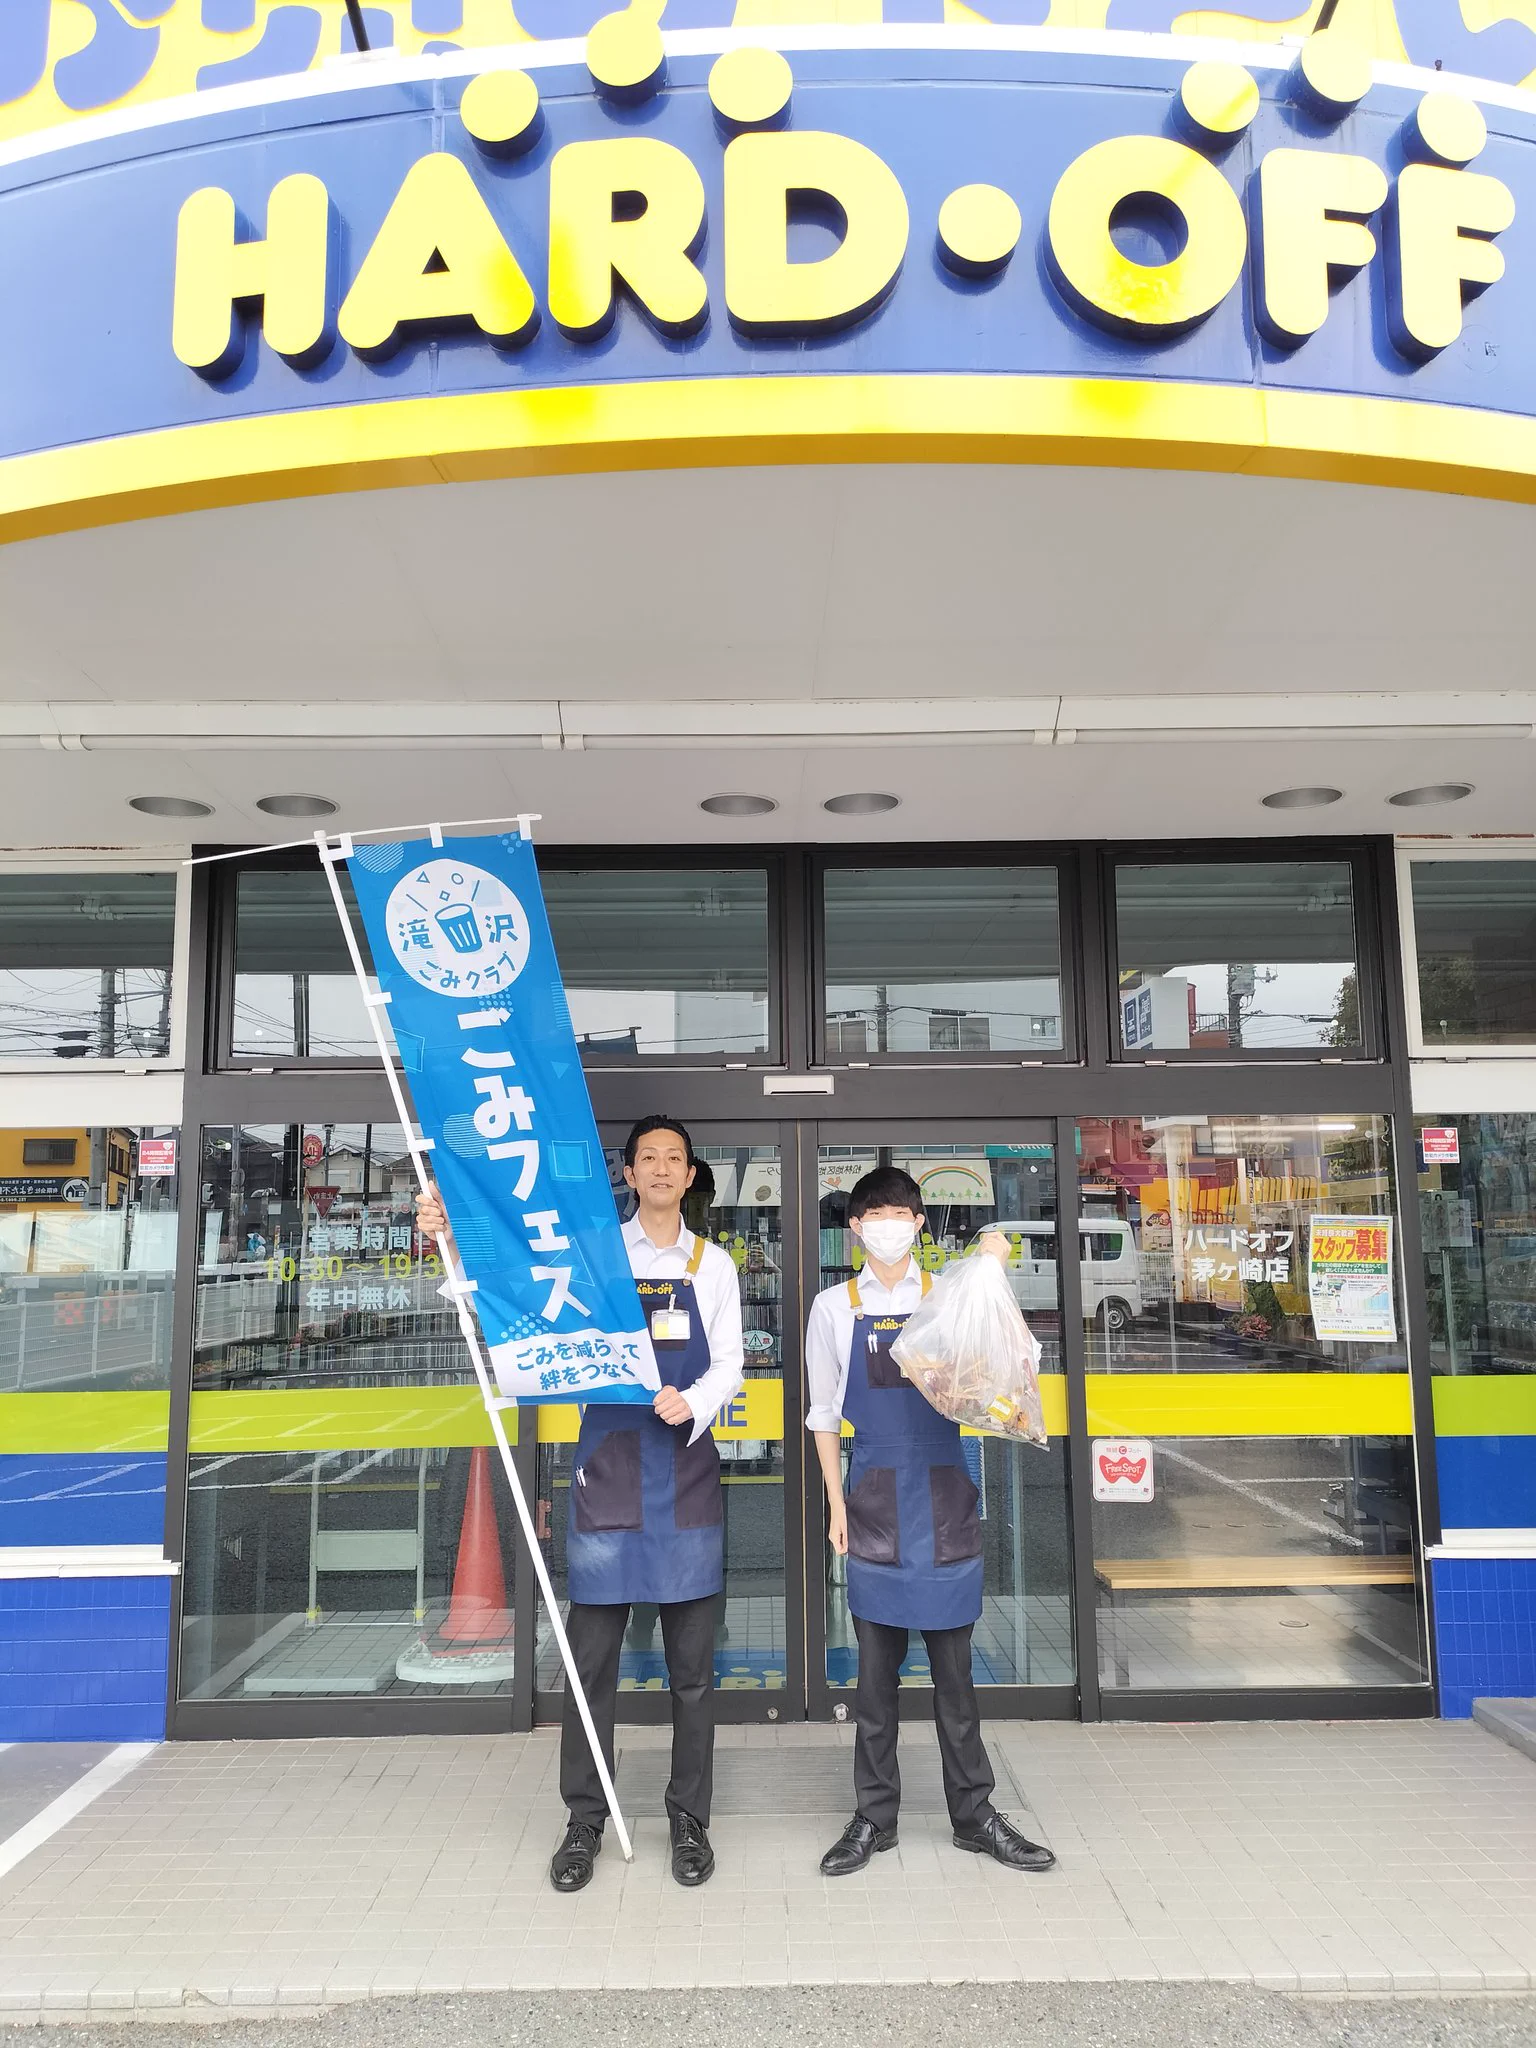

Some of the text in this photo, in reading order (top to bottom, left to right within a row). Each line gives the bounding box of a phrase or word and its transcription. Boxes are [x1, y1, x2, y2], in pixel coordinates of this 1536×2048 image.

[418, 950, 516, 991] ごみクラブ
[457, 1007, 592, 1323] ごみフェス
[308, 1226, 413, 1250] 営業時間
[1184, 1229, 1294, 1252] ハードオフ
[306, 1285, 412, 1311] 年中無休
